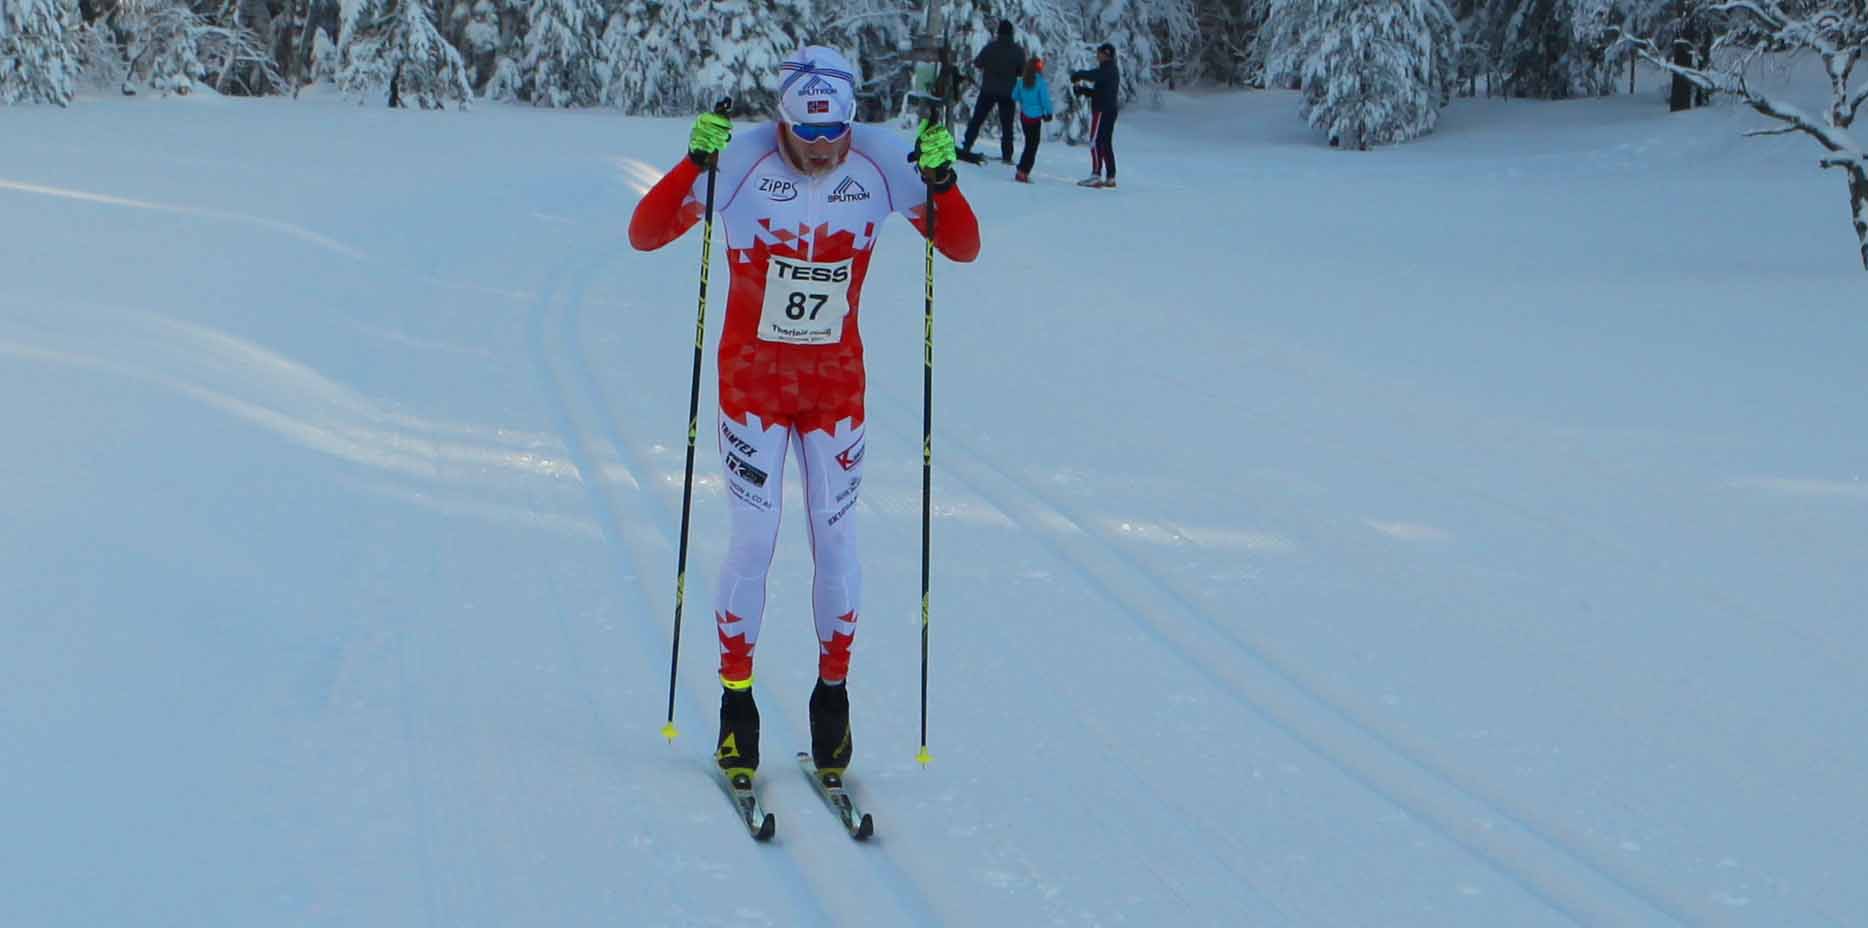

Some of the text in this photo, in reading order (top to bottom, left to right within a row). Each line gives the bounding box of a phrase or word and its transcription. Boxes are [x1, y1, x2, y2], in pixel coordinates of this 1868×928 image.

[827, 191, 870, 203] SPLITKON
[775, 260, 848, 283] TESS
[785, 292, 829, 320] 87
